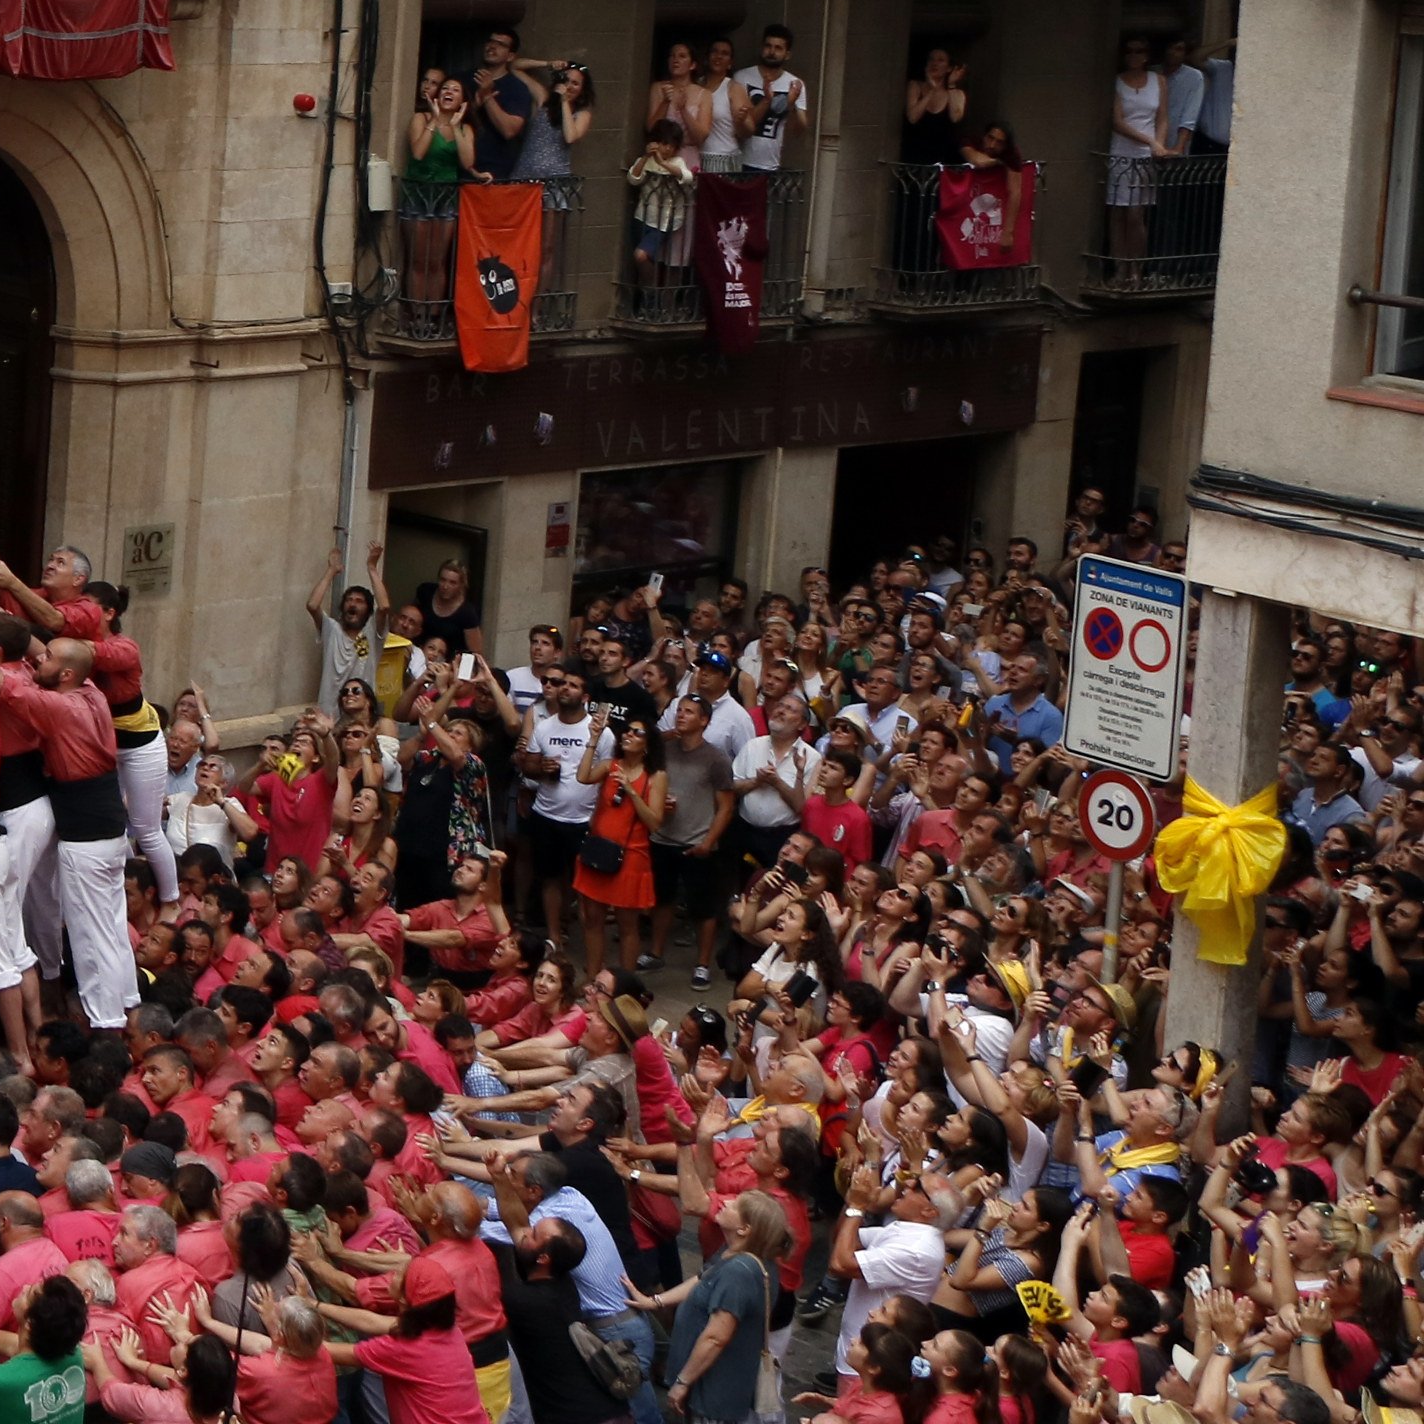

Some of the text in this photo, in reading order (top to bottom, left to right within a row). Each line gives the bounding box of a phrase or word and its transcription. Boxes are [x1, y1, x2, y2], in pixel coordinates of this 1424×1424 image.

[426, 372, 488, 404] BAR
[562, 352, 729, 391] TERRASSA
[596, 401, 872, 459] VALENTINA
[1100, 572, 1142, 589] Ajuntament
[1144, 583, 1153, 592] de
[1089, 590, 1174, 619] ZONA DE VIANANTS
[1109, 665, 1141, 680] Excepte
[1080, 739, 1111, 755] Prohibit
[1113, 750, 1156, 768] estacionar
[1097, 798, 1134, 831] 20
